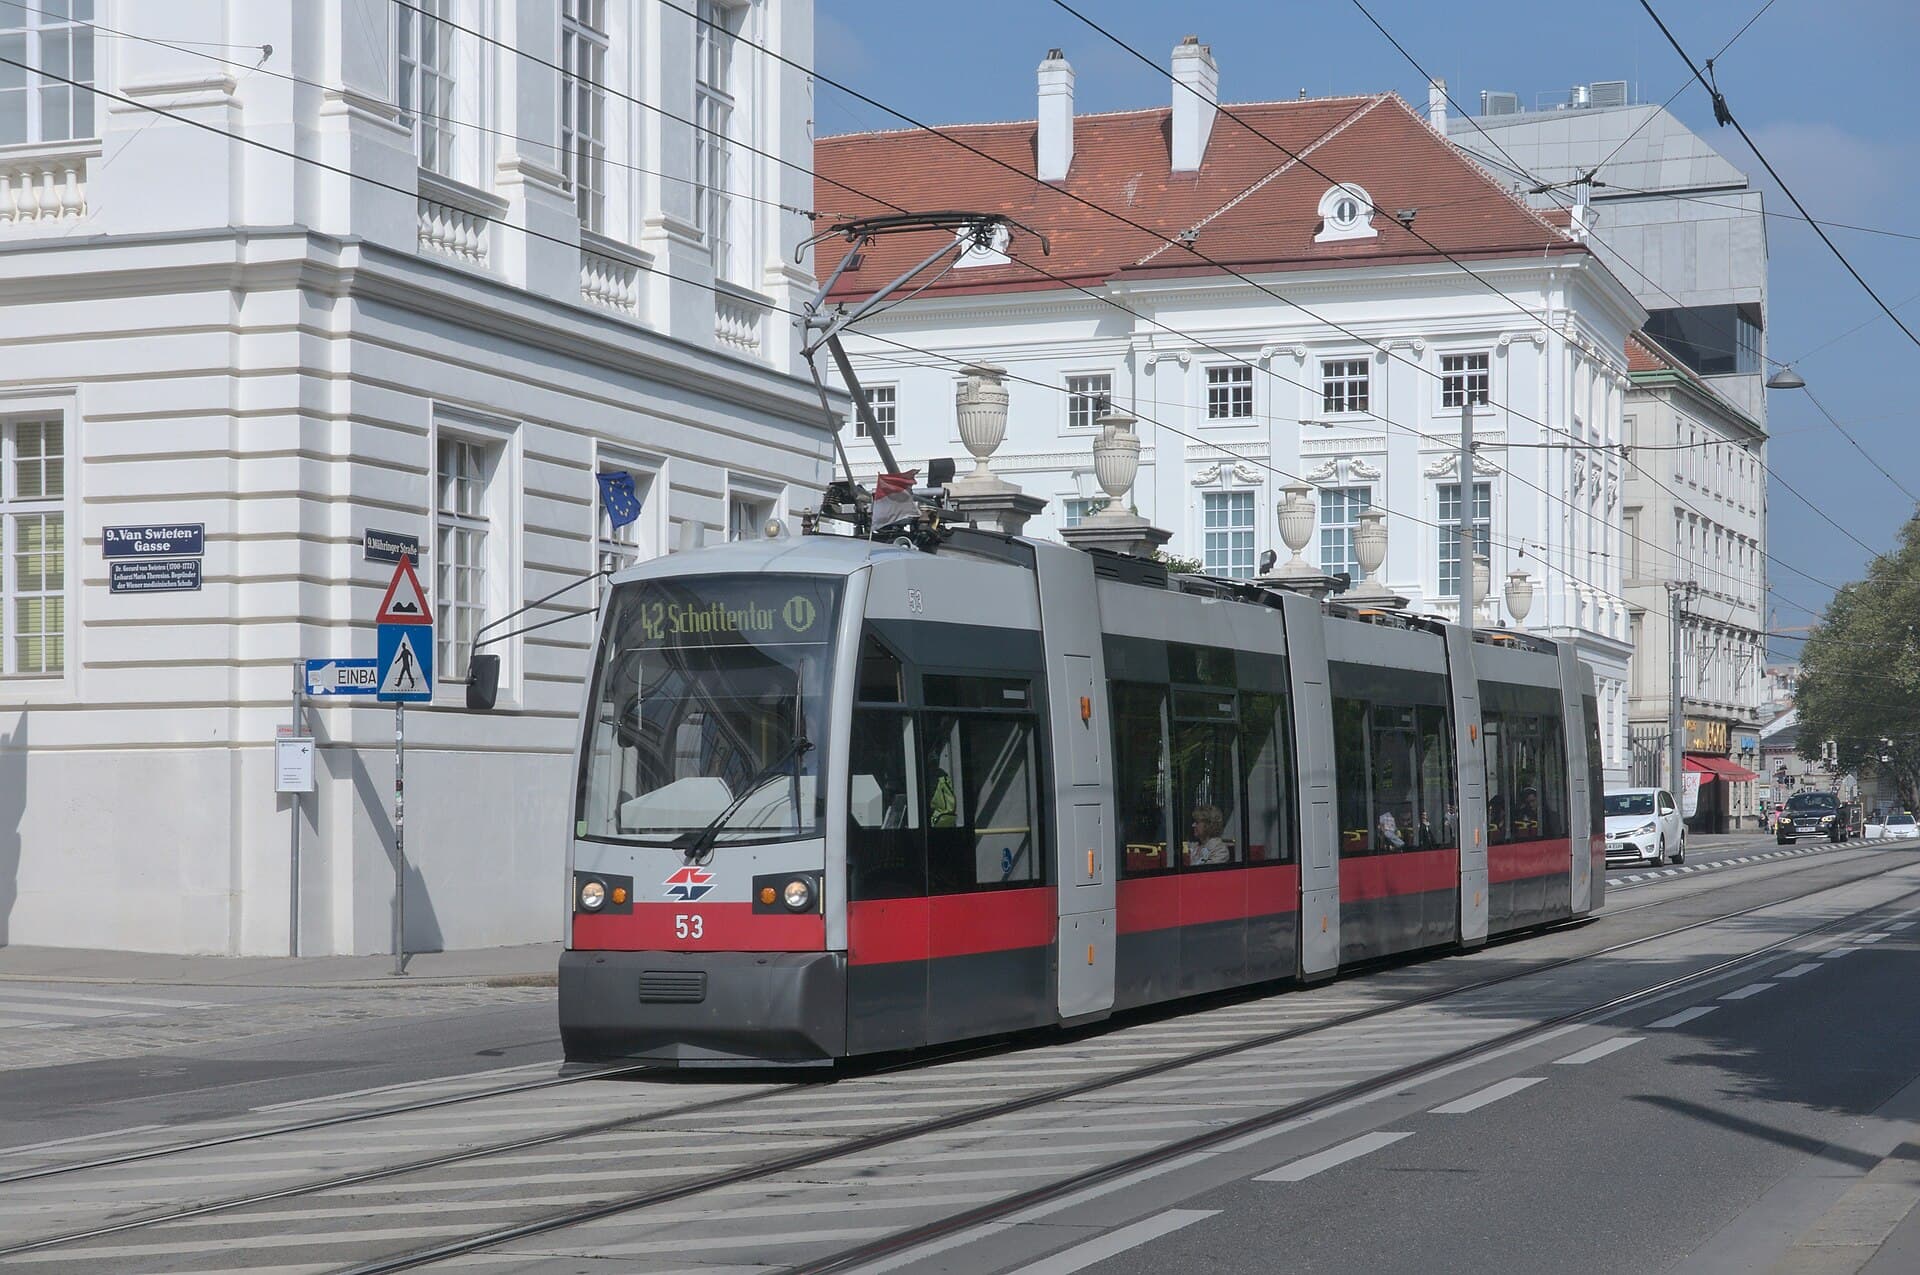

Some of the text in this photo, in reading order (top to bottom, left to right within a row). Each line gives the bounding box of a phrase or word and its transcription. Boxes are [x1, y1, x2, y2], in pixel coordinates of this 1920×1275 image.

[119, 529, 142, 541] Van
[134, 541, 171, 552] Gasse
[908, 589, 922, 613] 53
[641, 602, 665, 640] 42
[668, 601, 777, 633] Schottentor
[338, 669, 377, 685] EINBA
[675, 914, 704, 939] 53
